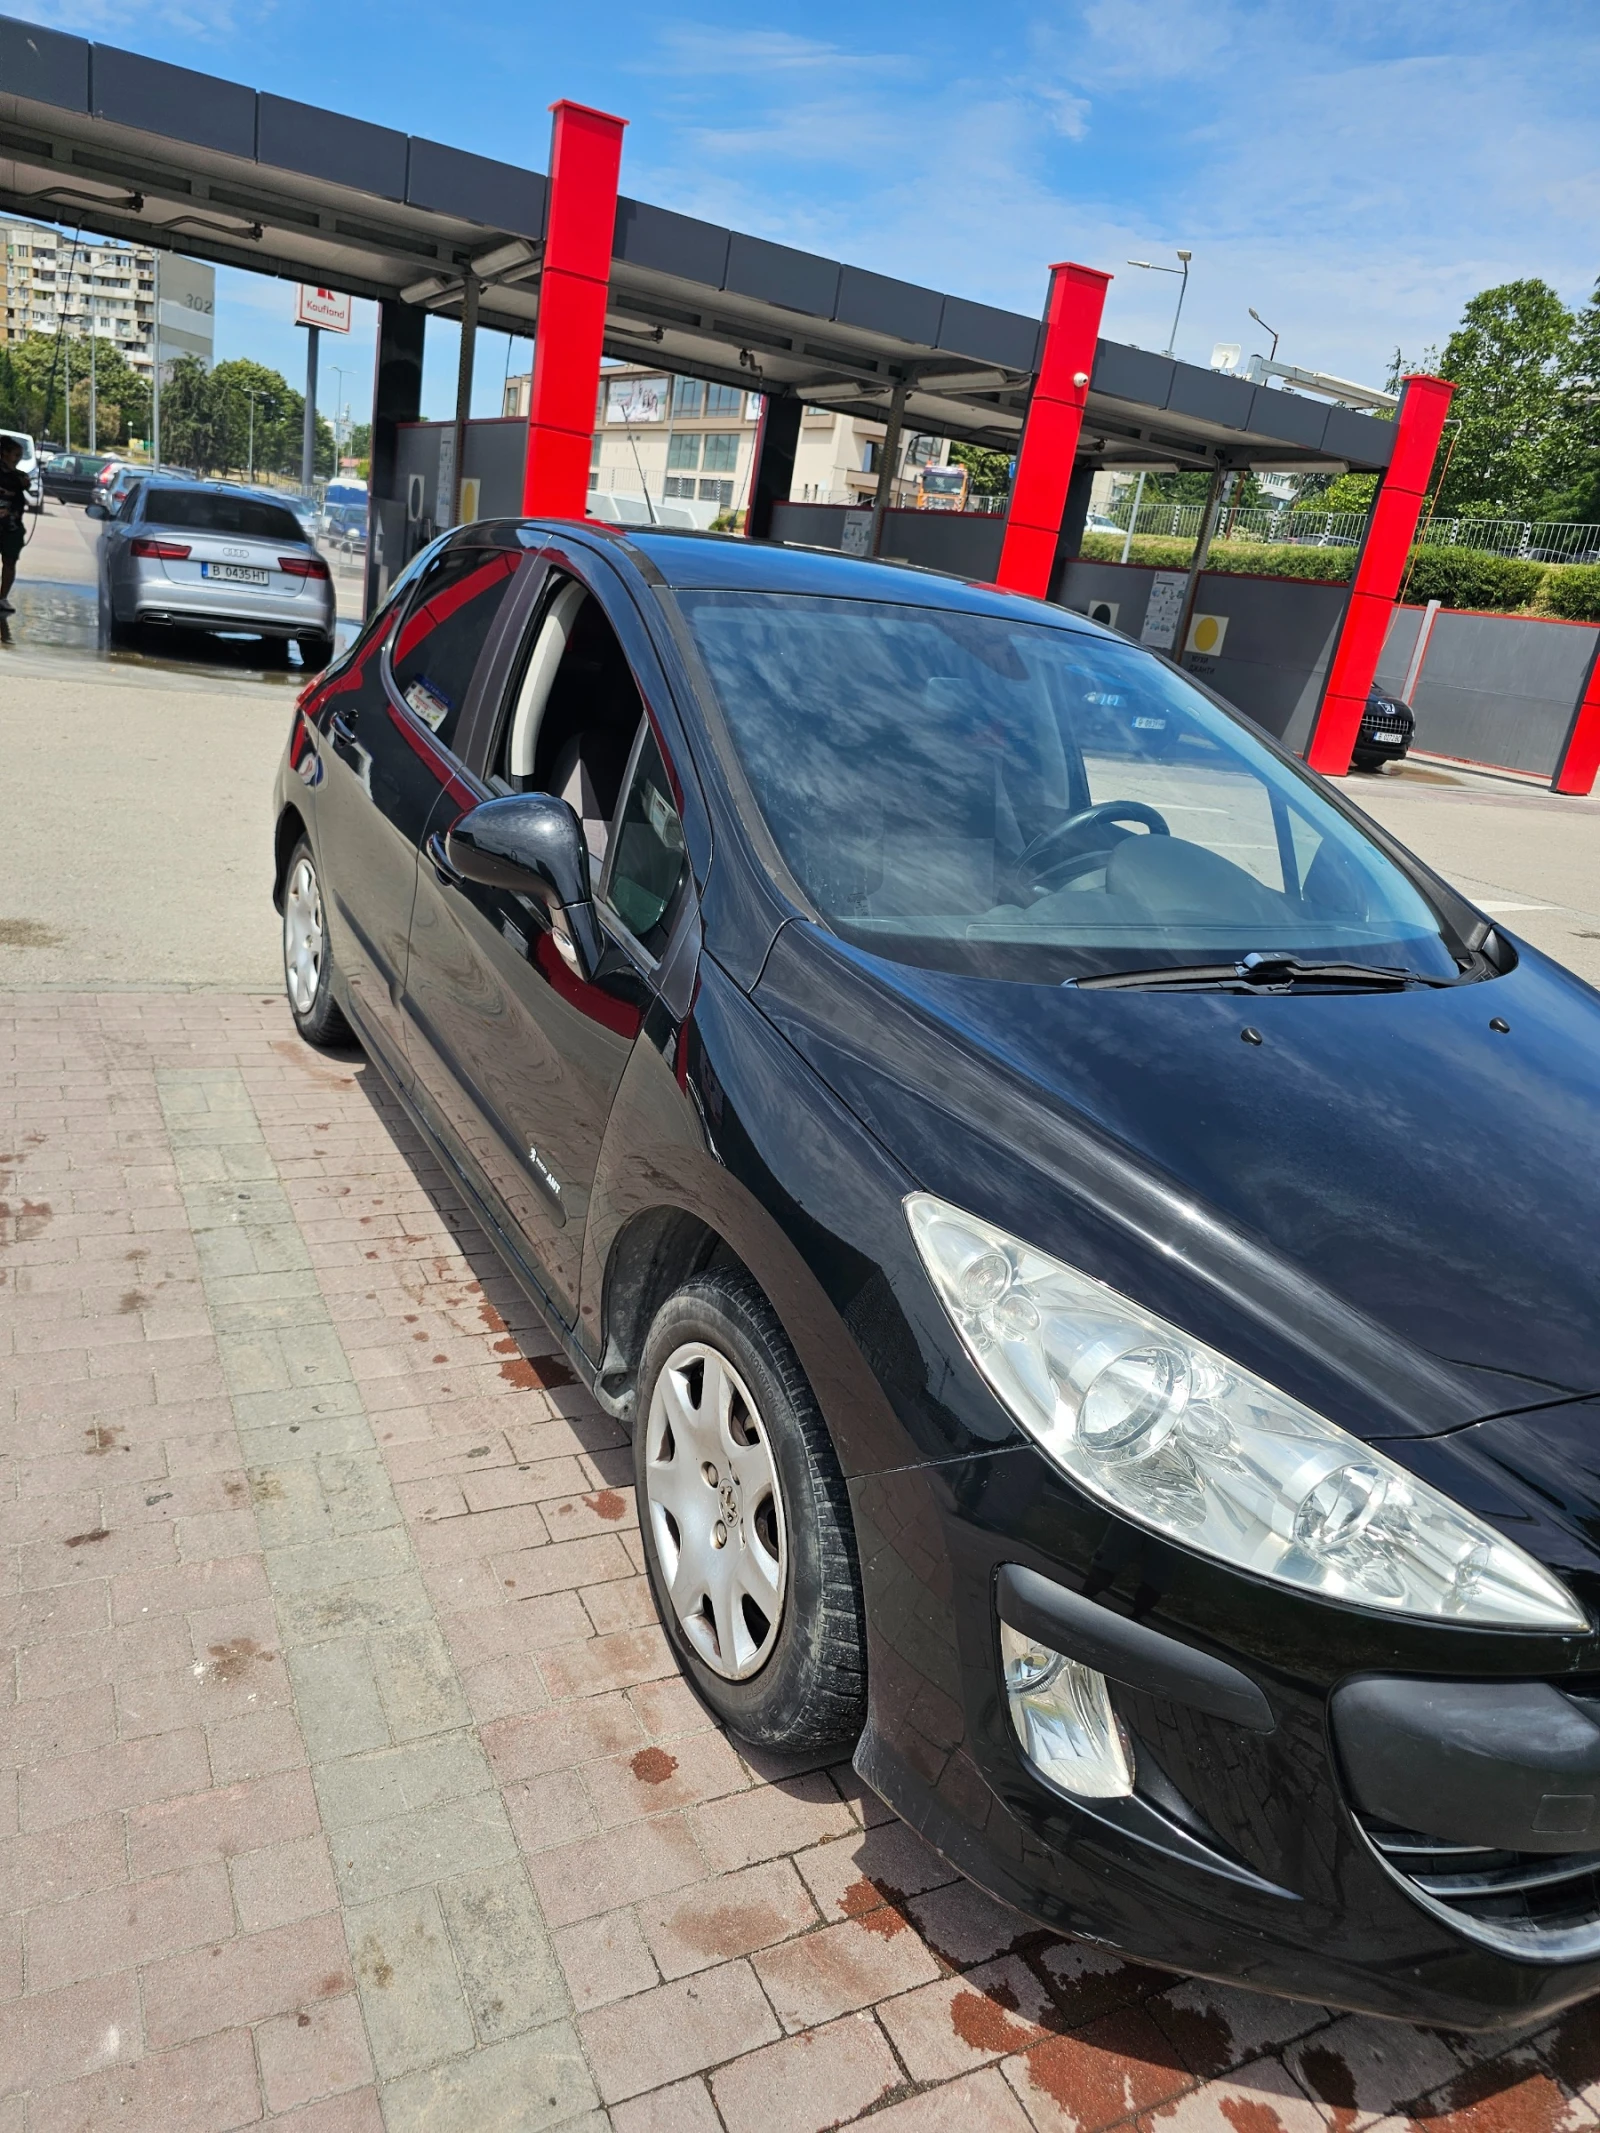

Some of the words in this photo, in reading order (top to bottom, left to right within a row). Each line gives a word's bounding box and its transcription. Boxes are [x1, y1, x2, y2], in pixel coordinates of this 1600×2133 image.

[185, 293, 213, 315] 302
[306, 300, 345, 319] Kaufland
[213, 565, 220, 576] B
